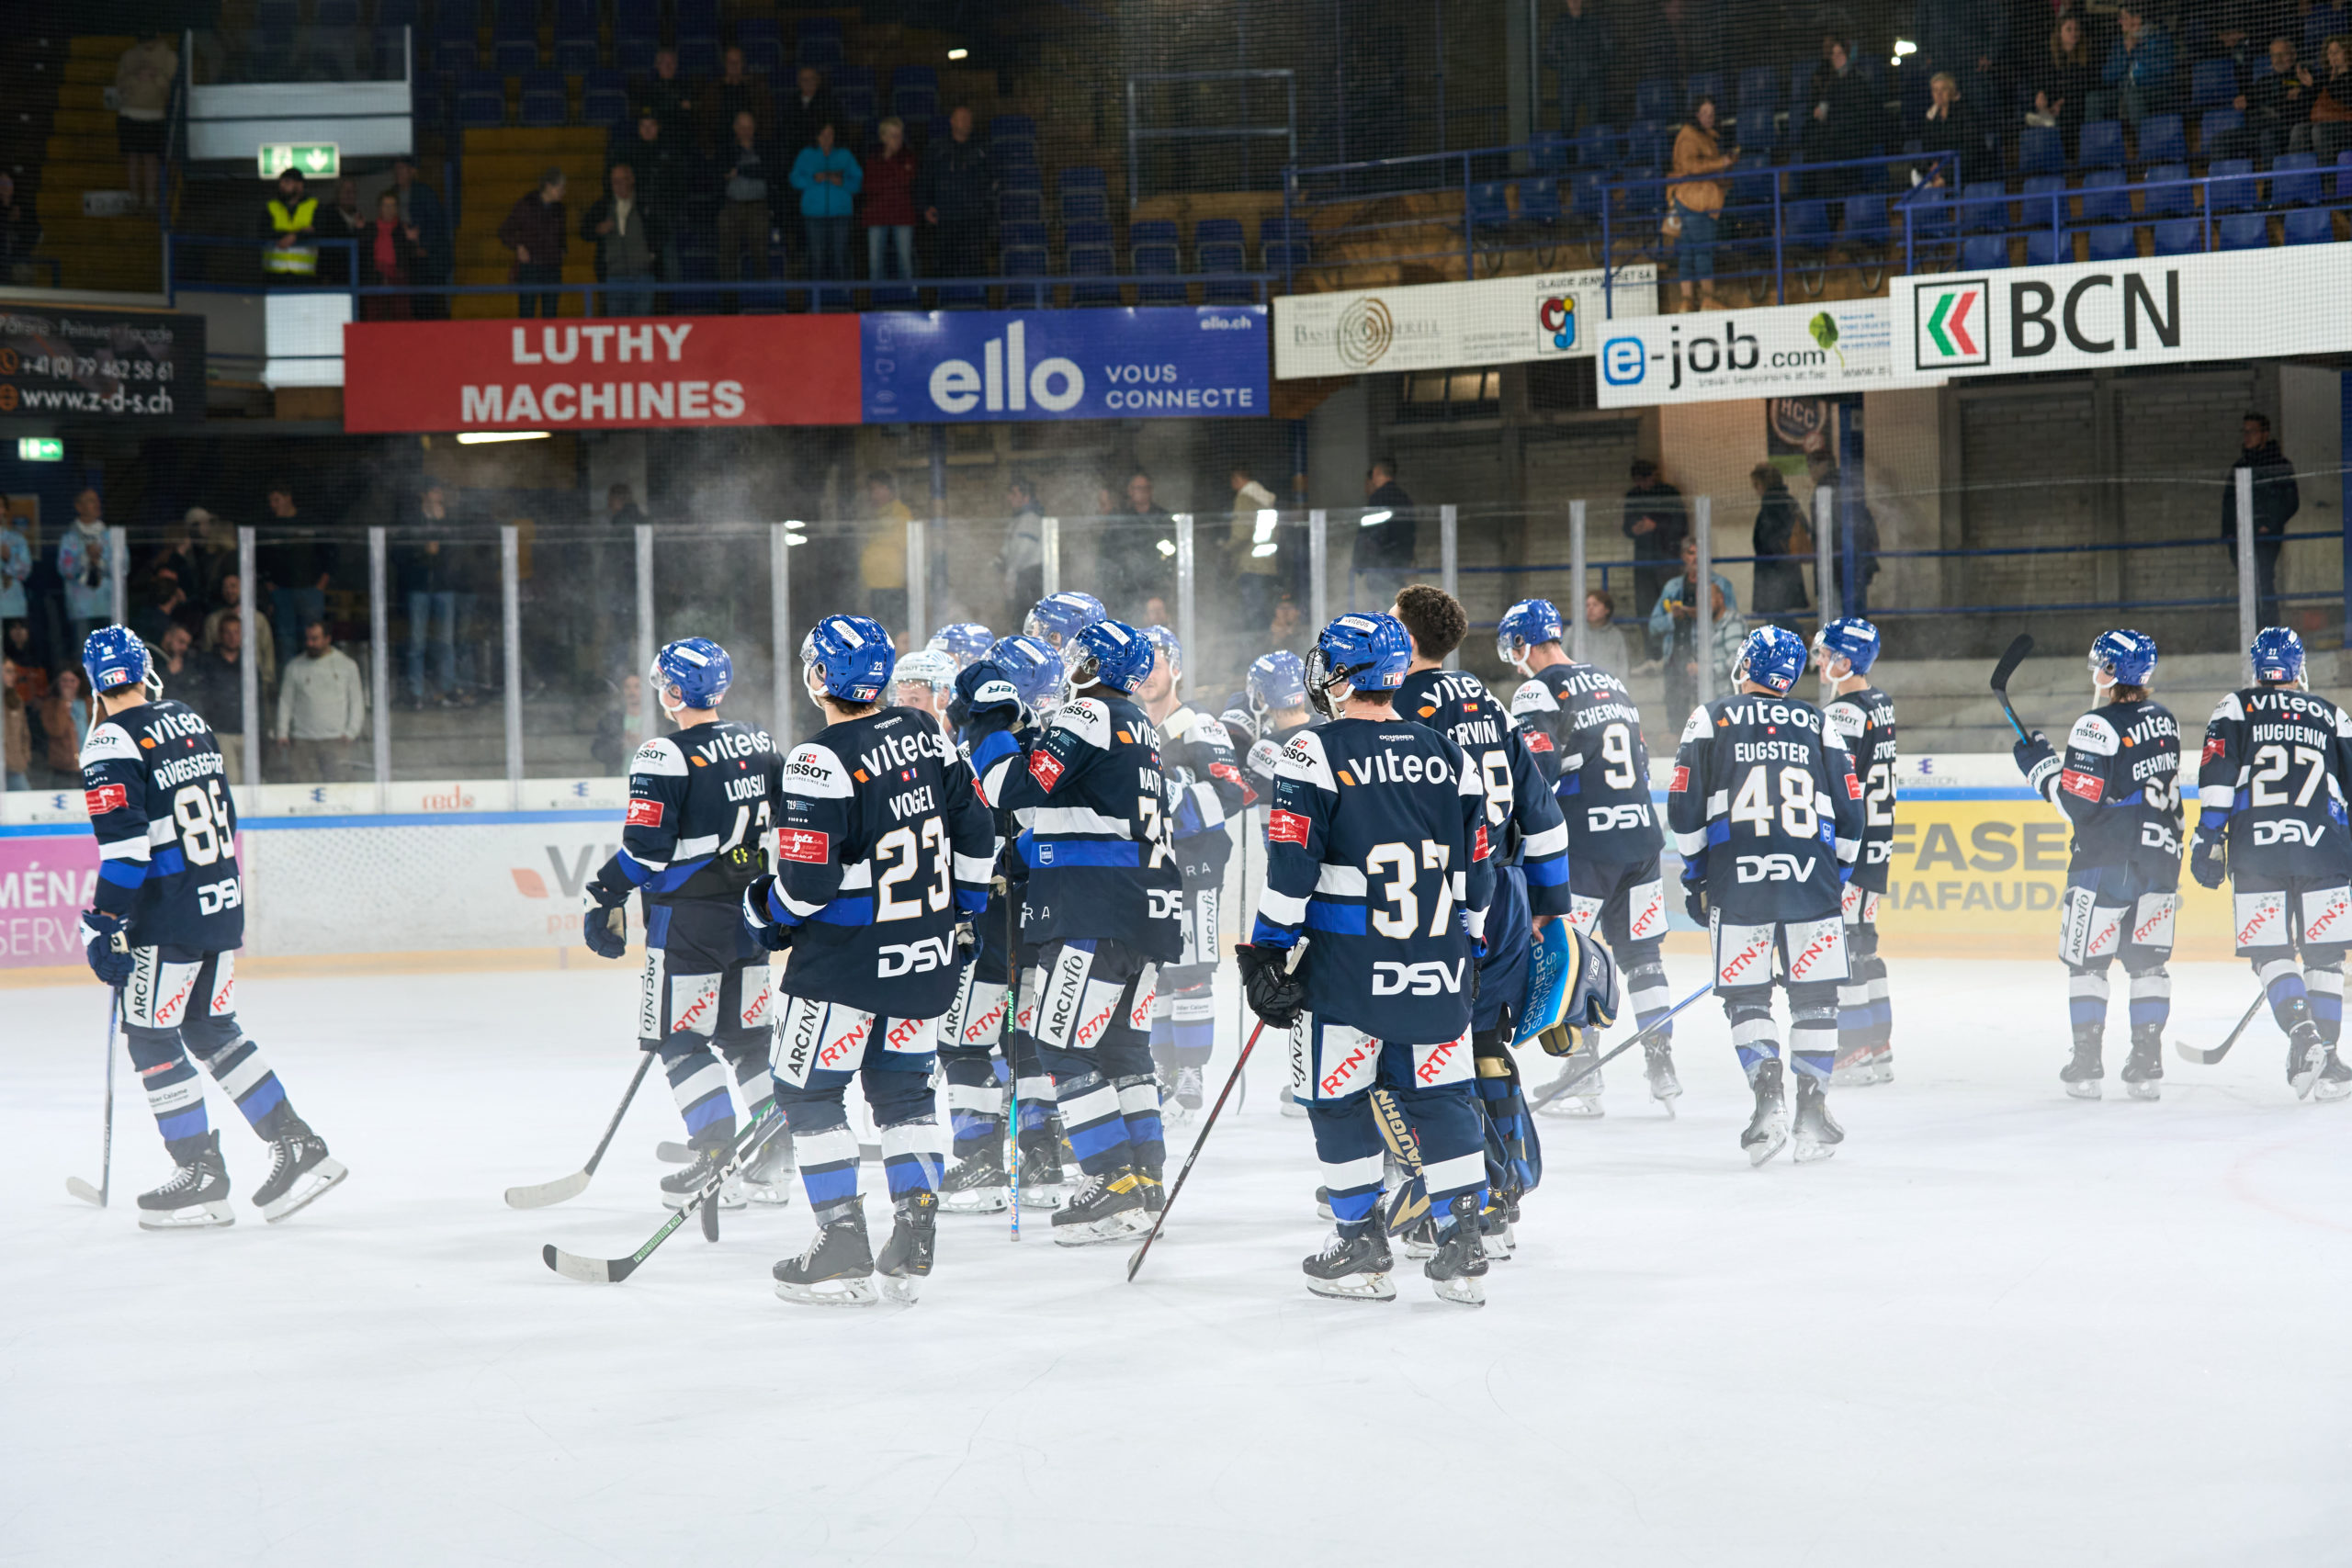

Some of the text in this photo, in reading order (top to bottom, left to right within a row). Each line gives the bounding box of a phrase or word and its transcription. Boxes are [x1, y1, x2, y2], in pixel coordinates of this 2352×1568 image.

[1200, 315, 1252, 331] ello.ch
[2010, 269, 2180, 358] BCN
[512, 323, 692, 365] LUTHY
[23, 355, 50, 375] +41
[51, 355, 73, 379] (0)
[77, 356, 96, 377] 79
[133, 359, 153, 380] 58
[156, 361, 174, 381] 61
[929, 319, 1085, 414] ello
[1105, 364, 1178, 384] VOUS
[21, 383, 174, 413] www.z-d-s.ch
[461, 380, 745, 423] MACHINES
[1105, 388, 1253, 410] CONNECTE
[839, 624, 858, 641] viteos
[1347, 617, 1369, 628] viteos
[873, 660, 883, 671] 23
[143, 712, 213, 745] viteo
[1725, 701, 1821, 735] viteos
[2251, 693, 2335, 728] viteos
[860, 730, 945, 777] viteos
[1735, 740, 1810, 765] EUGSTER
[2253, 723, 2327, 750] HUGUENIN
[786, 762, 832, 782] TISSOT
[1602, 723, 1637, 790] 9
[724, 773, 766, 802] LOOSLI
[2252, 744, 2325, 807] 27
[888, 784, 935, 821] VOGEL
[1731, 765, 1819, 840] 48
[1867, 763, 1896, 827] 2
[1588, 803, 1651, 832] DSV
[2253, 818, 2326, 848] DSV
[876, 815, 952, 923] 23
[1736, 852, 1816, 884] DSV
[1366, 839, 1453, 940] 37
[1631, 901, 1658, 937] RTN
[2134, 911, 2162, 942] RTN
[2237, 912, 2267, 945] RTN
[2306, 908, 2337, 942] RTN
[877, 929, 956, 978] DSV
[2088, 922, 2117, 954] RTN
[1372, 956, 1466, 996] DSV
[1721, 946, 1758, 984] RTN
[1791, 942, 1824, 980] RTN
[154, 987, 186, 1025] RTN
[673, 998, 707, 1032] RTN
[742, 988, 769, 1025] RTN
[965, 1006, 1002, 1043] RTN
[1077, 1007, 1111, 1045] RTN
[820, 1024, 865, 1067] RTN
[1417, 1040, 1459, 1085] RTN
[1320, 1047, 1366, 1096] RTN
